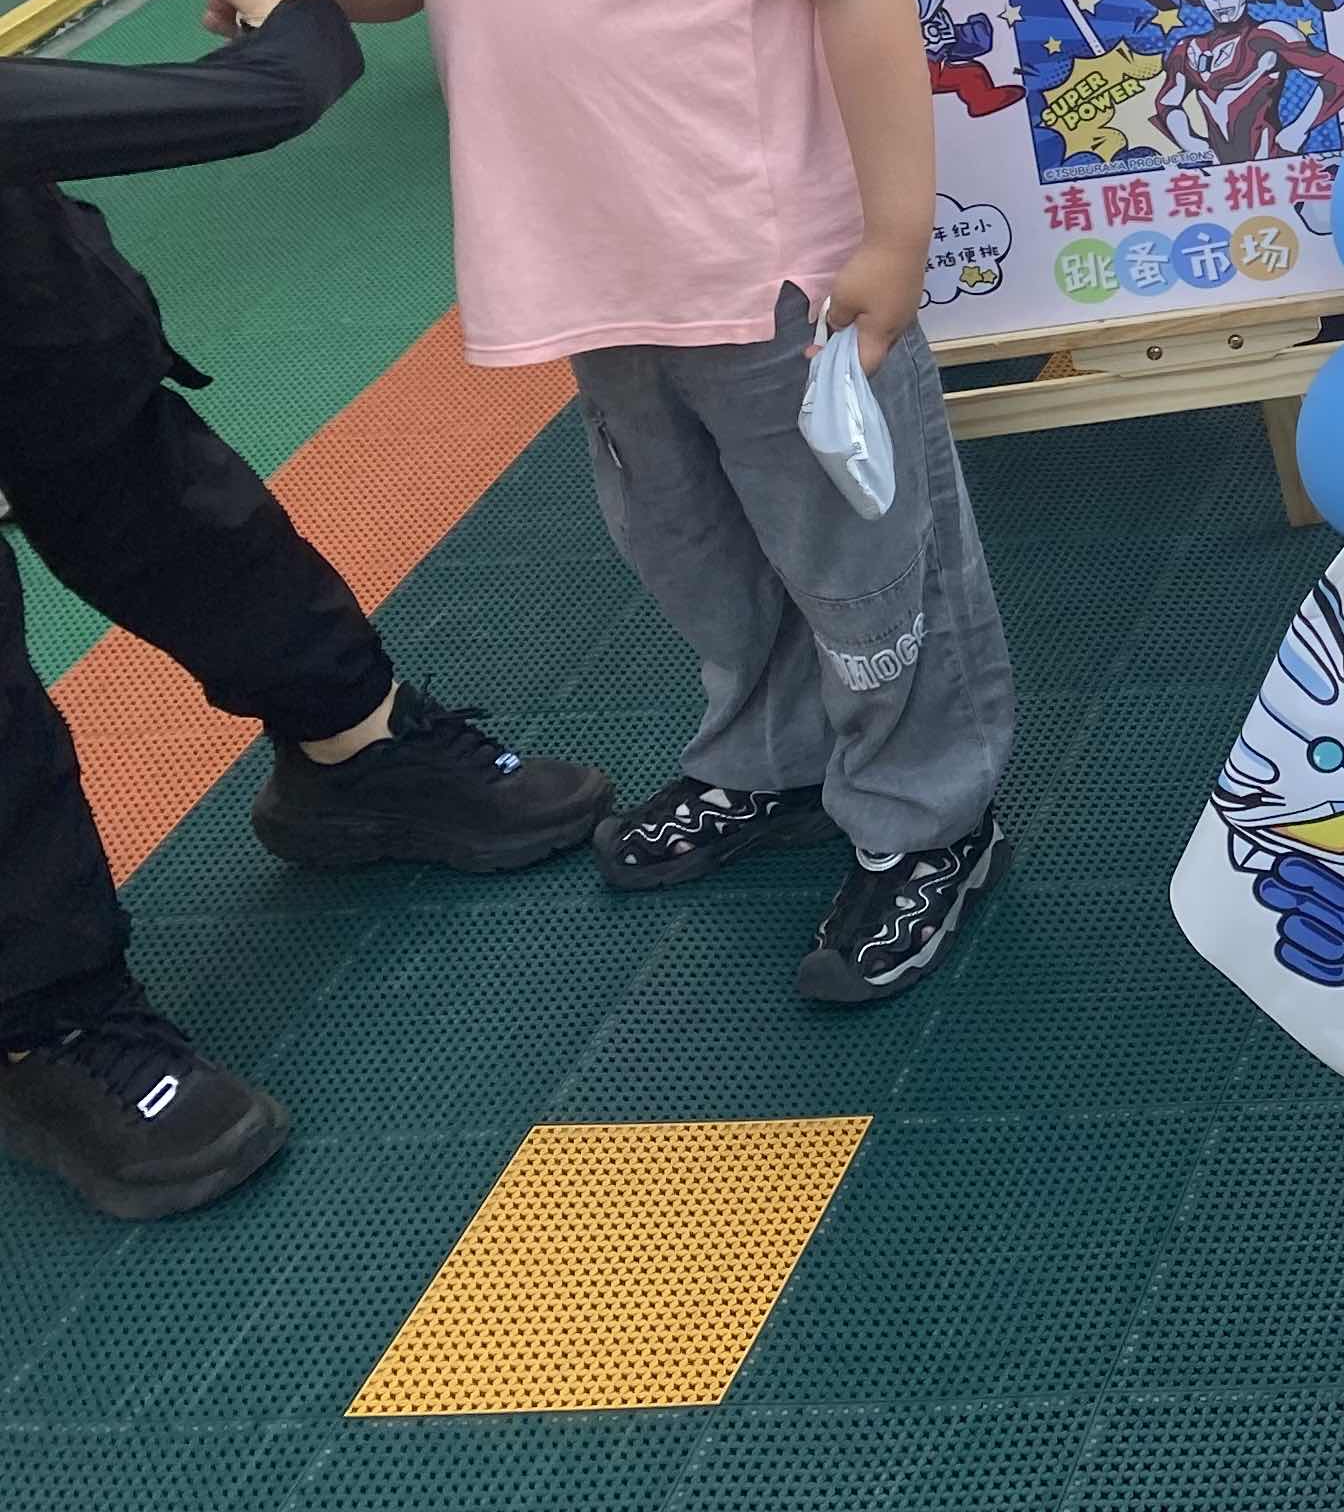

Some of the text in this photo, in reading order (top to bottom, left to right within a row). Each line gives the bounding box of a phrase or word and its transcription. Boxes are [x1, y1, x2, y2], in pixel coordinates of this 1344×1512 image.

[1040, 70, 1108, 127] SUPER
[1064, 76, 1146, 131] POWER
[1129, 150, 1216, 172] PRODUCTIONS
[1044, 159, 1334, 233] 请随意挑选
[1060, 226, 1291, 294] 跳蚤市场
